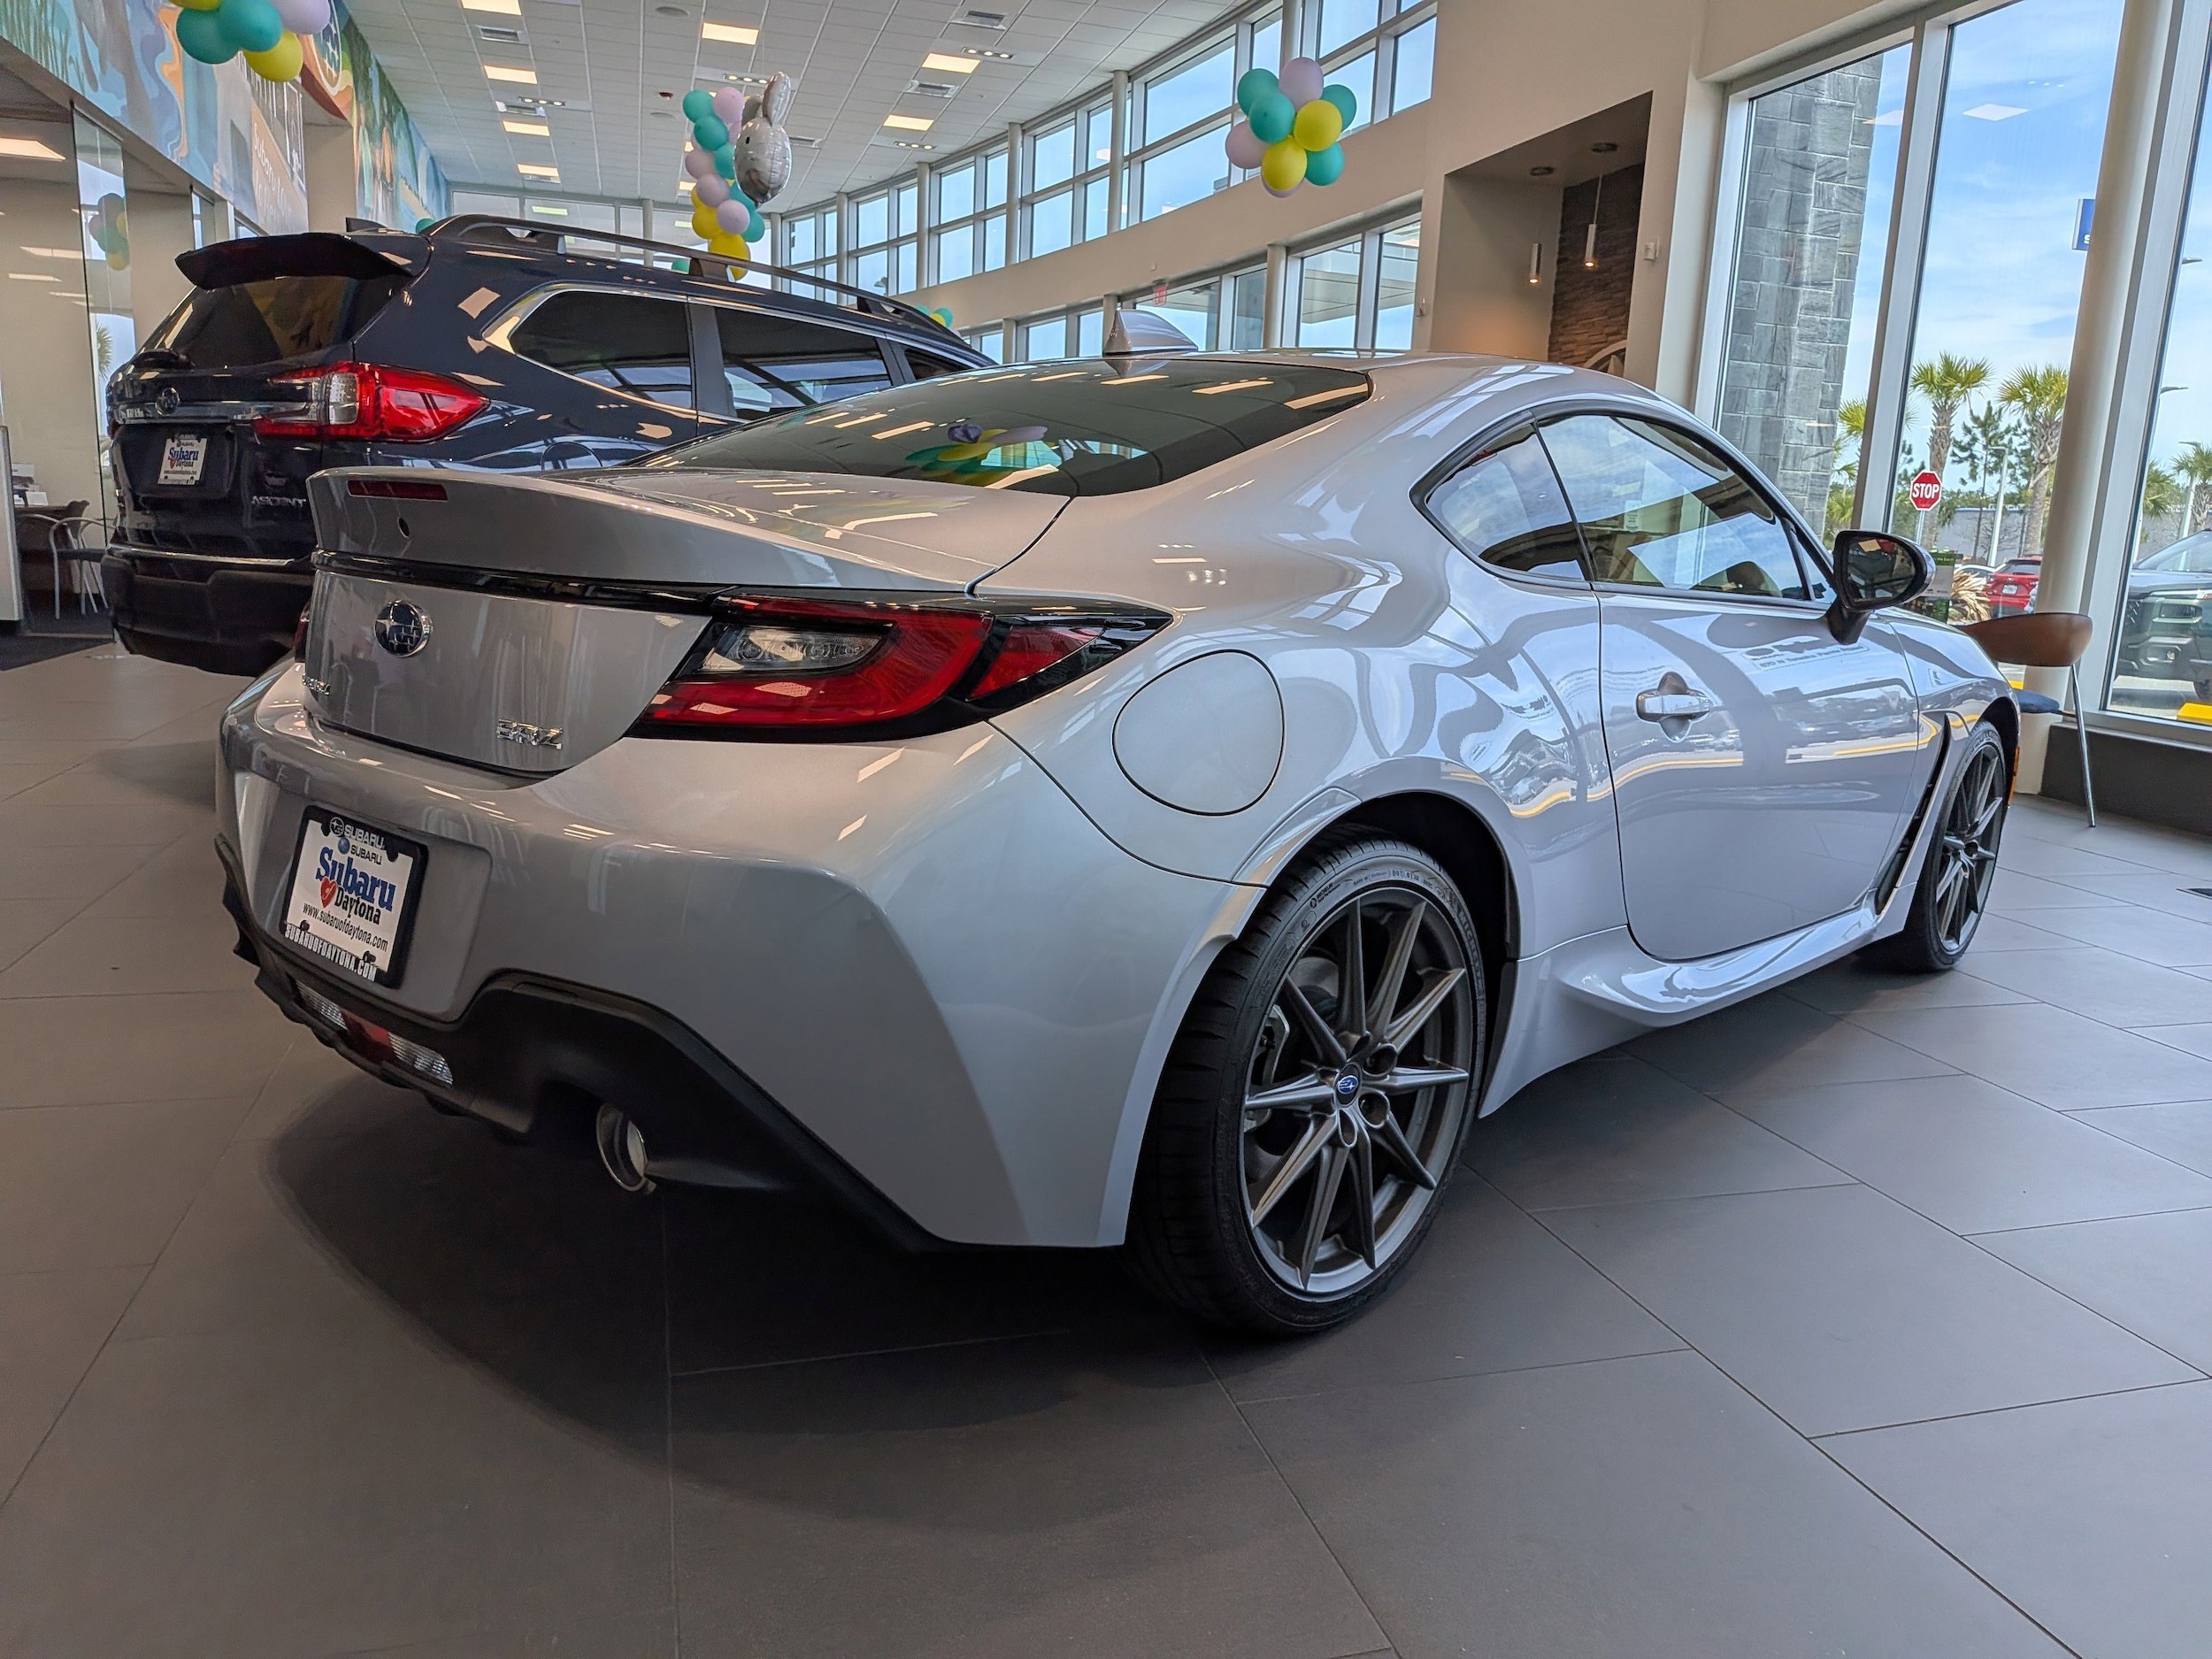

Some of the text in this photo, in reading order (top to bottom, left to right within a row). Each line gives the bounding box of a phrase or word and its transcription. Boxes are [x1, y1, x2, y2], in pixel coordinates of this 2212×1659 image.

[168, 447, 199, 461] Subaru
[1912, 482, 1939, 499] STOP
[344, 824, 384, 850] SUBARU
[350, 844, 382, 865] SUBARU
[315, 847, 396, 912] Subaru
[334, 887, 381, 926] Daytona
[303, 902, 388, 952] www.subaruofdaytona.com
[285, 924, 377, 982] SUBARUOFDAYTONA.COM
